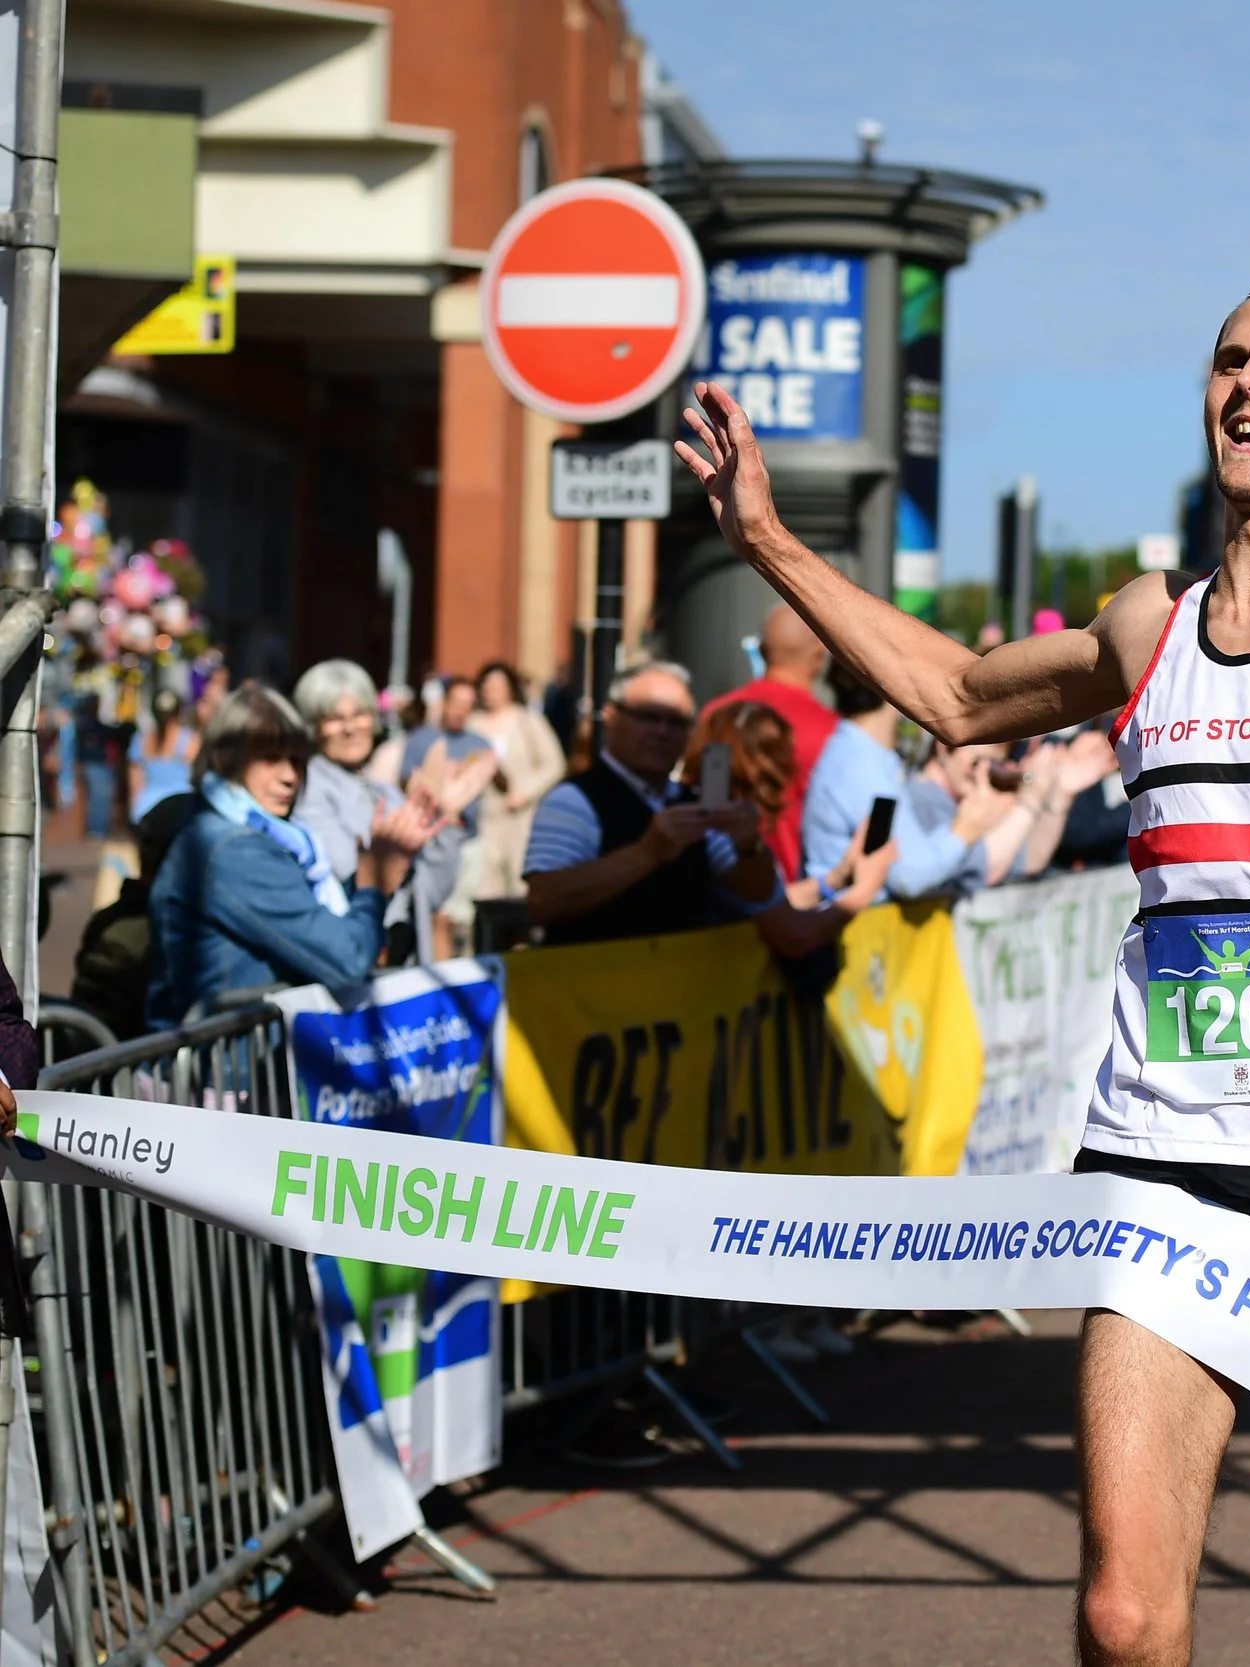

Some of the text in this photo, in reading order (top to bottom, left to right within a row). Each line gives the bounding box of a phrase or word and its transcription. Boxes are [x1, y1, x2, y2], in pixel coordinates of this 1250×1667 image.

[718, 314, 862, 374] SALE
[566, 482, 653, 508] cycles
[1169, 719, 1201, 742] OF
[54, 1117, 174, 1174] Hanley
[271, 1150, 636, 1259] FINISH LINE
[710, 1217, 769, 1255] THE
[768, 1220, 892, 1261] HANLEY
[891, 1220, 1030, 1261] BUILDING
[1031, 1219, 1230, 1301] SOCIETY'S
